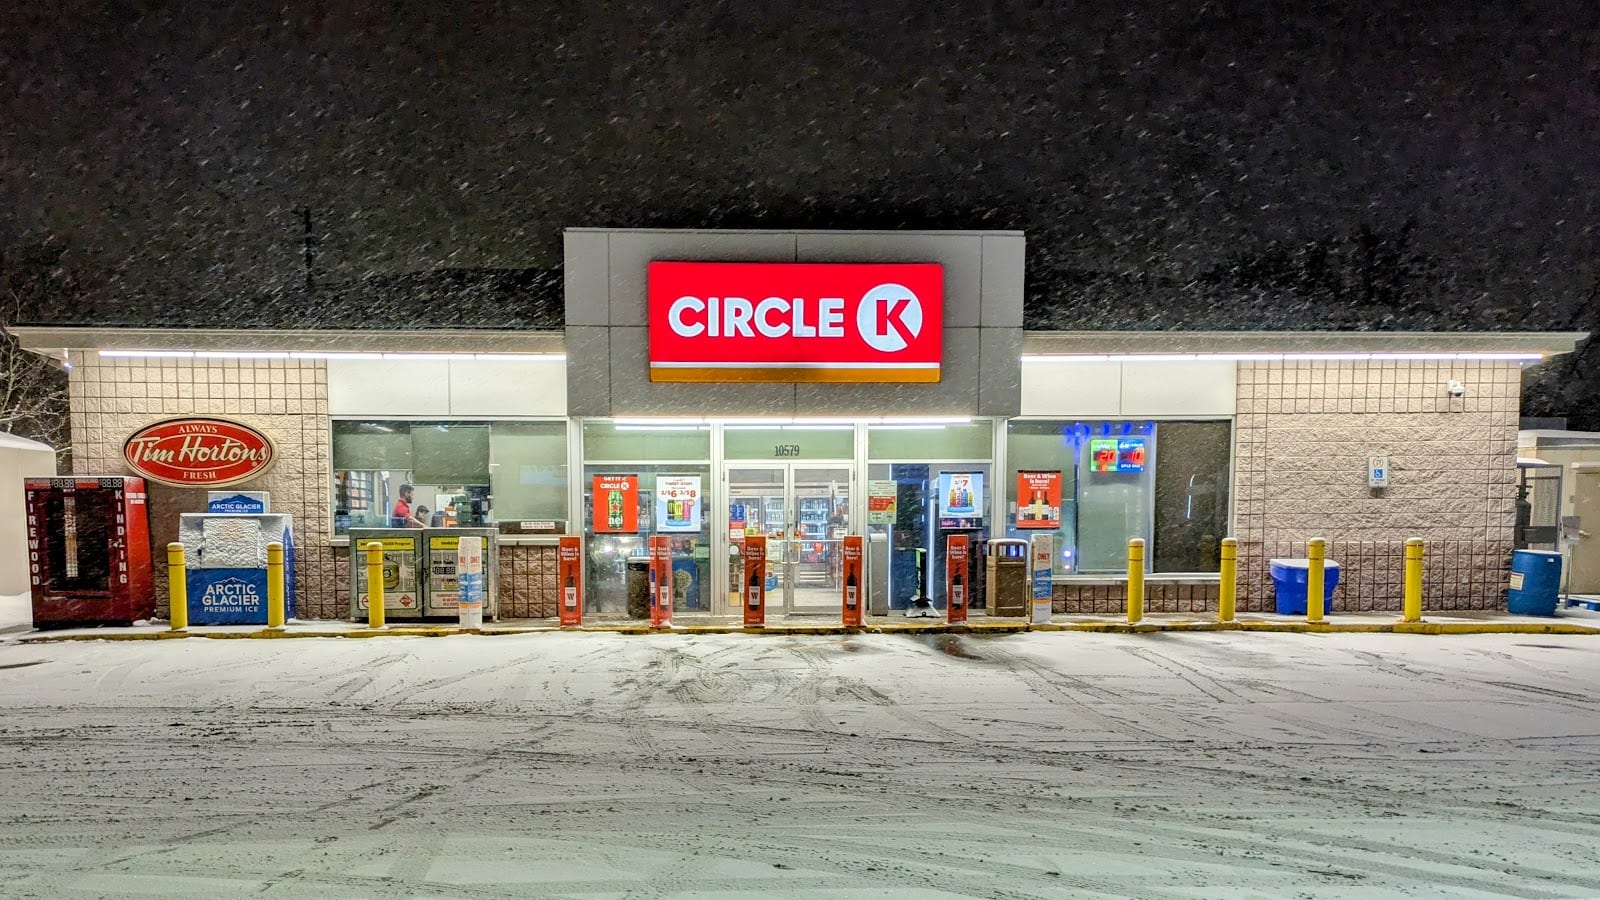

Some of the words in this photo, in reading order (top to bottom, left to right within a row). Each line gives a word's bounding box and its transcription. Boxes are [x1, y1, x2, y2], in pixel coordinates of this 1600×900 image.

[668, 296, 845, 338] CIRCLE
[178, 425, 217, 433] ALWAYS
[130, 437, 174, 463] Tim
[179, 435, 267, 463] Hortons
[774, 444, 800, 457] 10579
[1099, 450, 1115, 461] 20
[1131, 450, 1142, 461] 10
[183, 471, 217, 479] FRESH
[28, 491, 40, 585] FIREWOOD
[115, 490, 128, 584] KINDLING
[205, 584, 256, 595] ARCTIC
[202, 595, 260, 606] GLACIER
